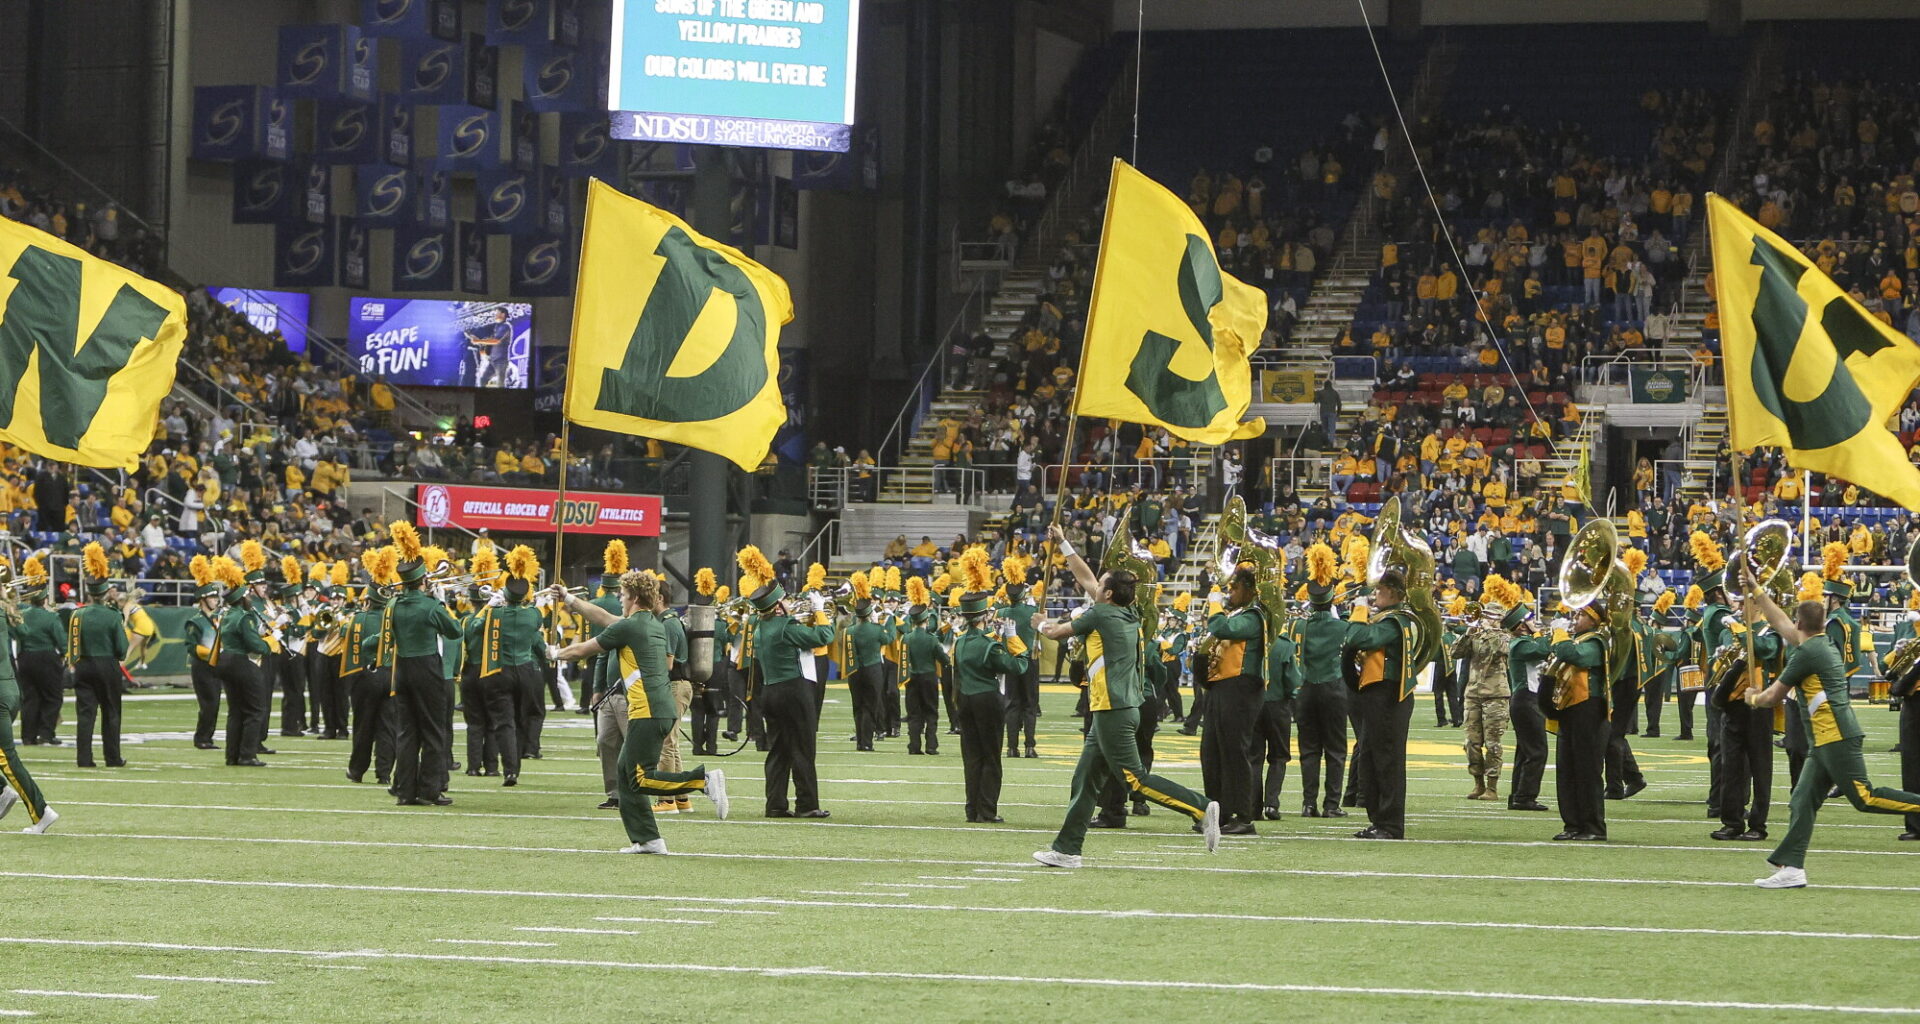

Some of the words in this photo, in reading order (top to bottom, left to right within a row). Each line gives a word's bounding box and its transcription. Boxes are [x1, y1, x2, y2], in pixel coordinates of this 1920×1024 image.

[654, 0, 695, 14] SONS
[696, 0, 715, 16] OF
[720, 0, 746, 17] THE
[747, 0, 793, 21] GREEN
[794, 2, 824, 24] AND
[677, 19, 736, 44] YELLOW
[736, 23, 802, 48] PRAIRIES
[645, 54, 676, 77] OUR
[677, 56, 735, 81] COLORS
[736, 60, 770, 83] WILL
[771, 62, 808, 86] EVER
[808, 65, 829, 88] BE
[632, 114, 711, 141] NDSU
[714, 119, 761, 131] NORTH
[764, 122, 817, 136] DAKOTA
[714, 130, 755, 143] STATE
[757, 133, 832, 147] UNIVERSITY
[366, 326, 419, 350] ESCAPE
[593, 225, 768, 421] D
[0, 245, 170, 449] N
[359, 354, 375, 374] TO
[376, 340, 429, 375] FUN!
[463, 500, 503, 515] OFFICIAL
[504, 502, 537, 516] GROCER
[538, 504, 550, 517] OF
[598, 507, 644, 521] ATHLETICS
[352, 623, 362, 665] NDSU
[491, 618, 500, 662] NDSU
[846, 634, 854, 667] NDSU
[1403, 627, 1412, 679] NDSU
